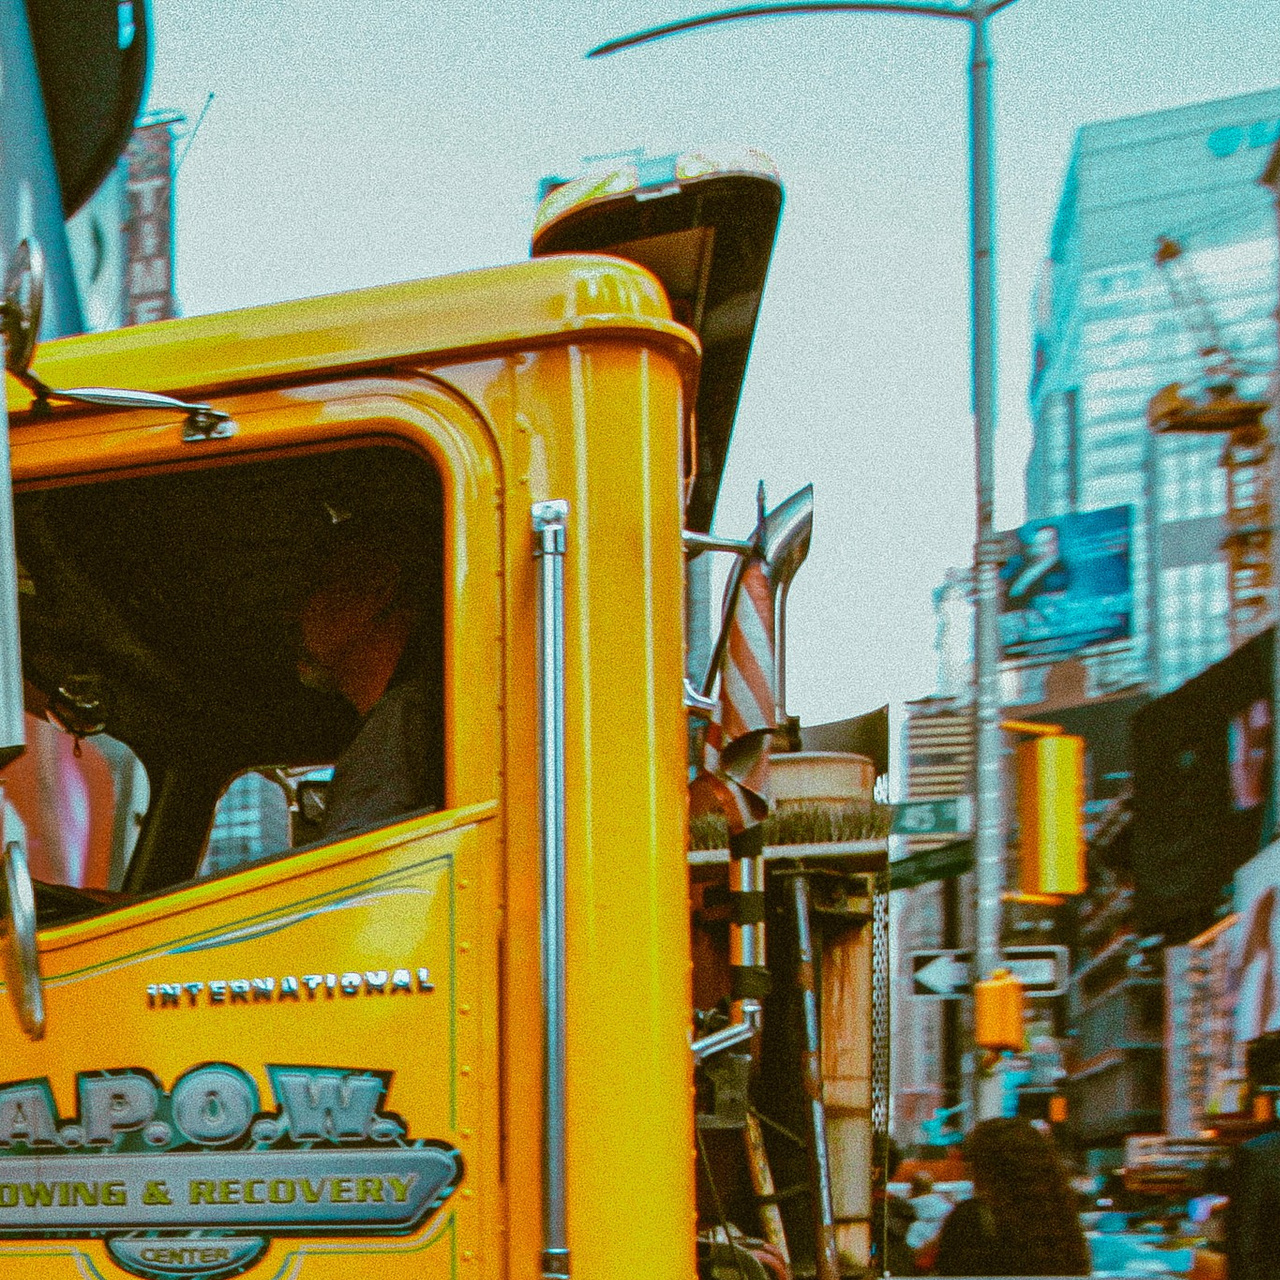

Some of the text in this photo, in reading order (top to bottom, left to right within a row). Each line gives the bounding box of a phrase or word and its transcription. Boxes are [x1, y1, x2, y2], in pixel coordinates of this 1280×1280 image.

[146, 966, 434, 1009] INTERNATIONAL
[140, 1179, 172, 1207] &
[189, 1172, 418, 1206] RECOVERY
[139, 1246, 231, 1266] CENTER
